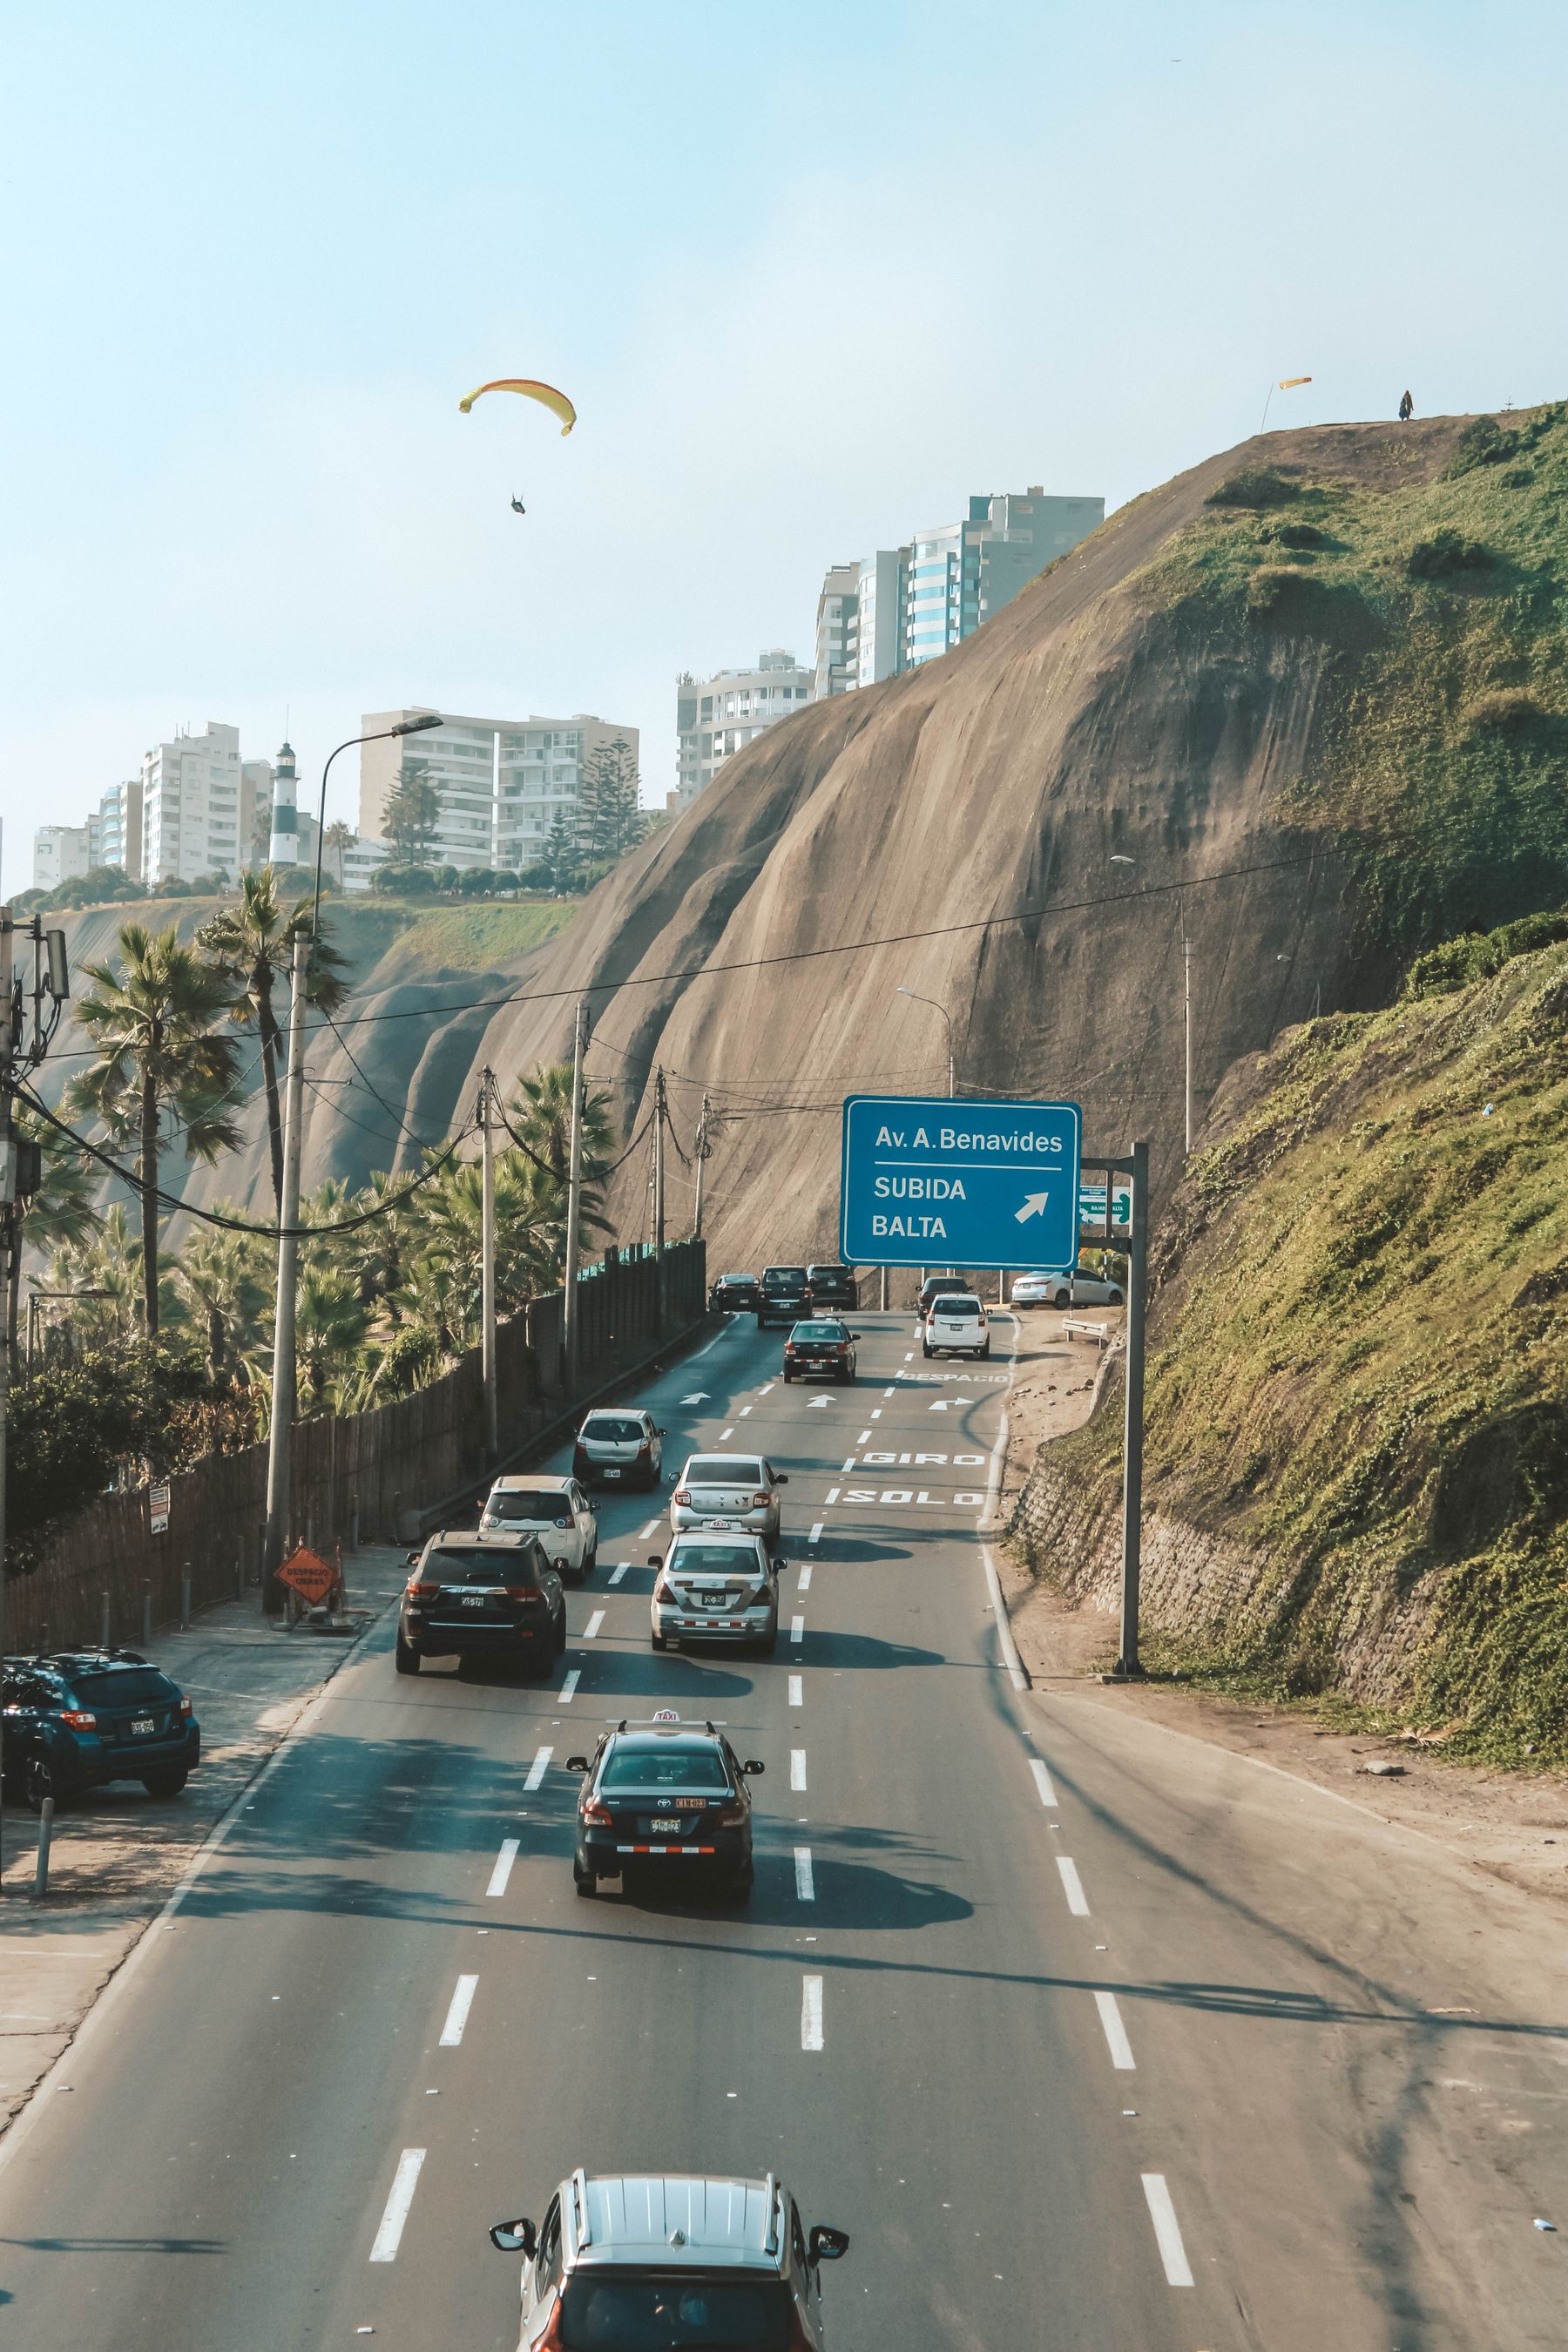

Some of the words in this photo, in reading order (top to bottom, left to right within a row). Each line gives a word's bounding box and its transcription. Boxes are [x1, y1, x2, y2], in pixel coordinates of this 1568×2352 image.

[875, 1125, 908, 1147] Av.
[940, 1128, 1063, 1152] Benavides
[874, 1176, 967, 1200] SUBIDA
[872, 1214, 947, 1238] BALTA
[901, 1373, 1009, 1382] DESPACIO
[862, 1452, 986, 1465] GIRO
[841, 1490, 984, 1505] SOLO
[287, 1567, 330, 1576] DESPACIO
